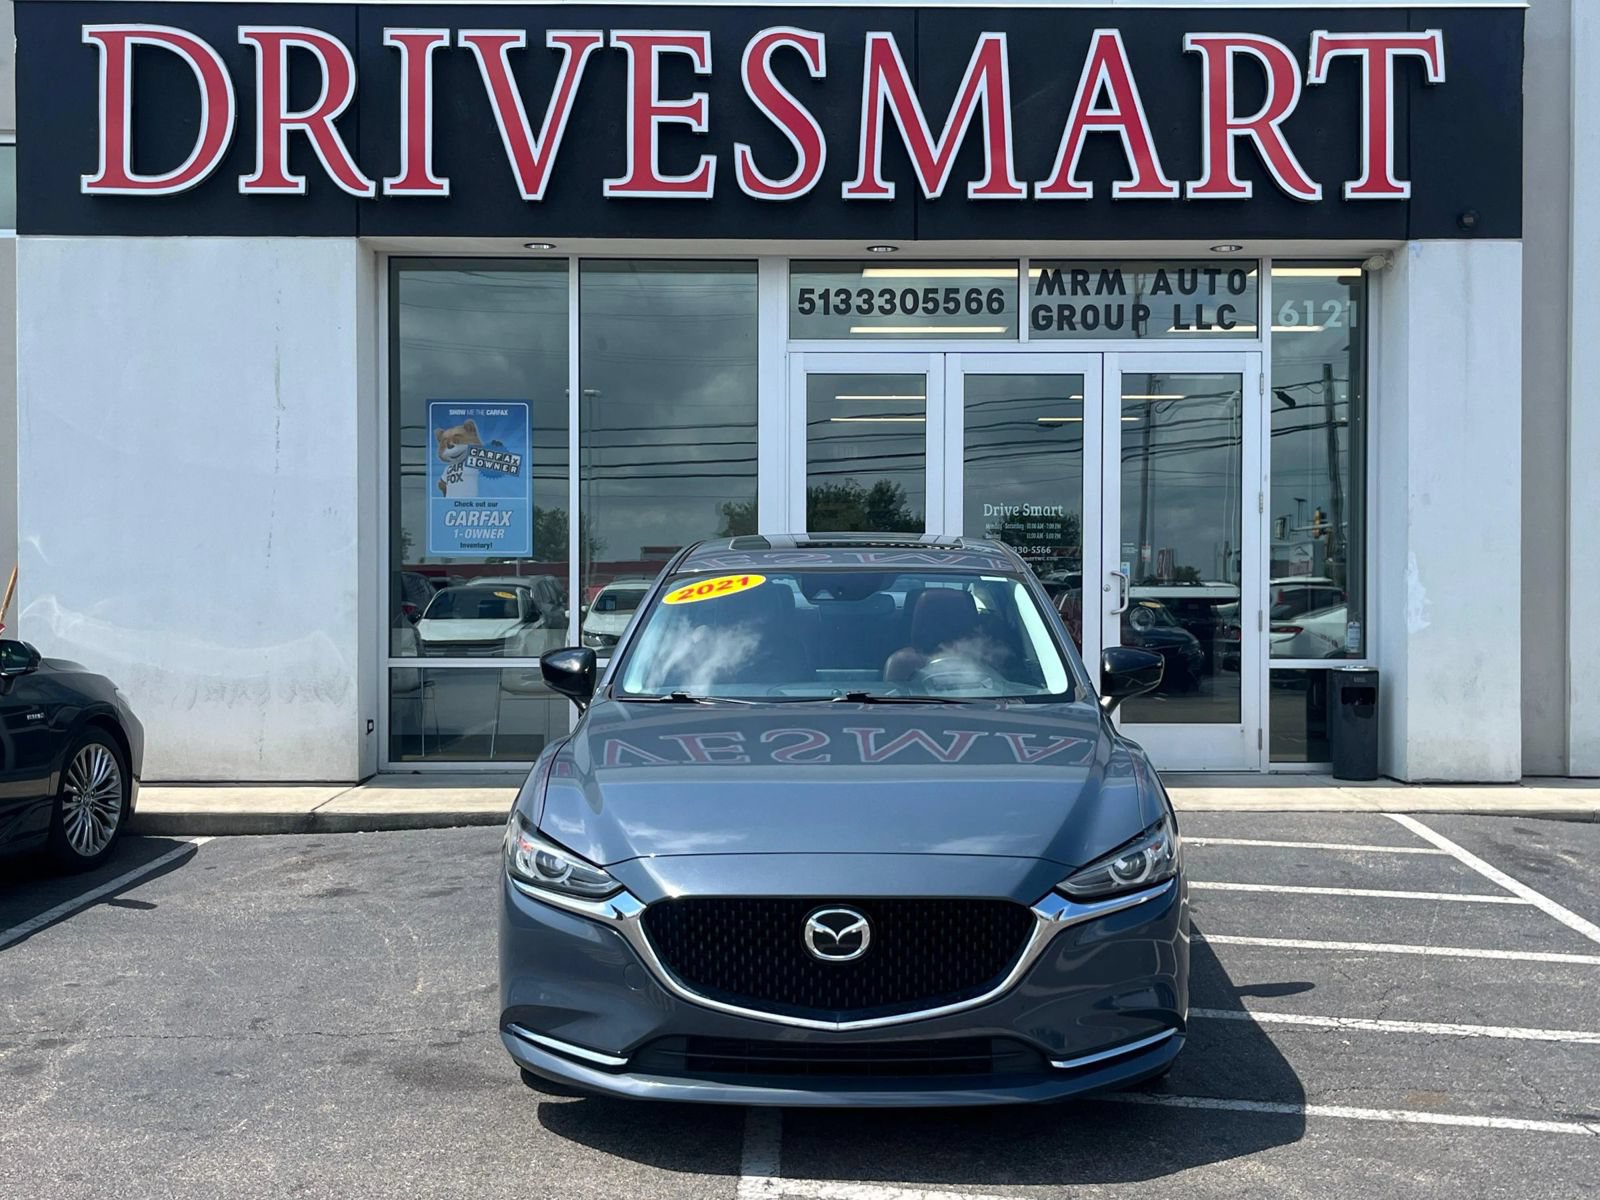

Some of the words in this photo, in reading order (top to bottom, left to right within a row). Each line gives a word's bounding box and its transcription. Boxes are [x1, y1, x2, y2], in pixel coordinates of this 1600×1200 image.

[81, 23, 1446, 203] DRIVESMART
[1035, 268, 1127, 296] MRM
[1150, 268, 1247, 296] AUTO
[798, 288, 1005, 316] 5133305566
[1278, 299, 1357, 328] 6121
[1031, 304, 1151, 331] GROUP
[1174, 304, 1237, 331] LLC
[470, 448, 520, 466] CARFAX
[445, 510, 513, 527] CARFAX
[983, 503, 1020, 516] Drive
[1022, 503, 1064, 517] Smart
[460, 542, 493, 550] Inventory!
[675, 576, 750, 602] 2021
